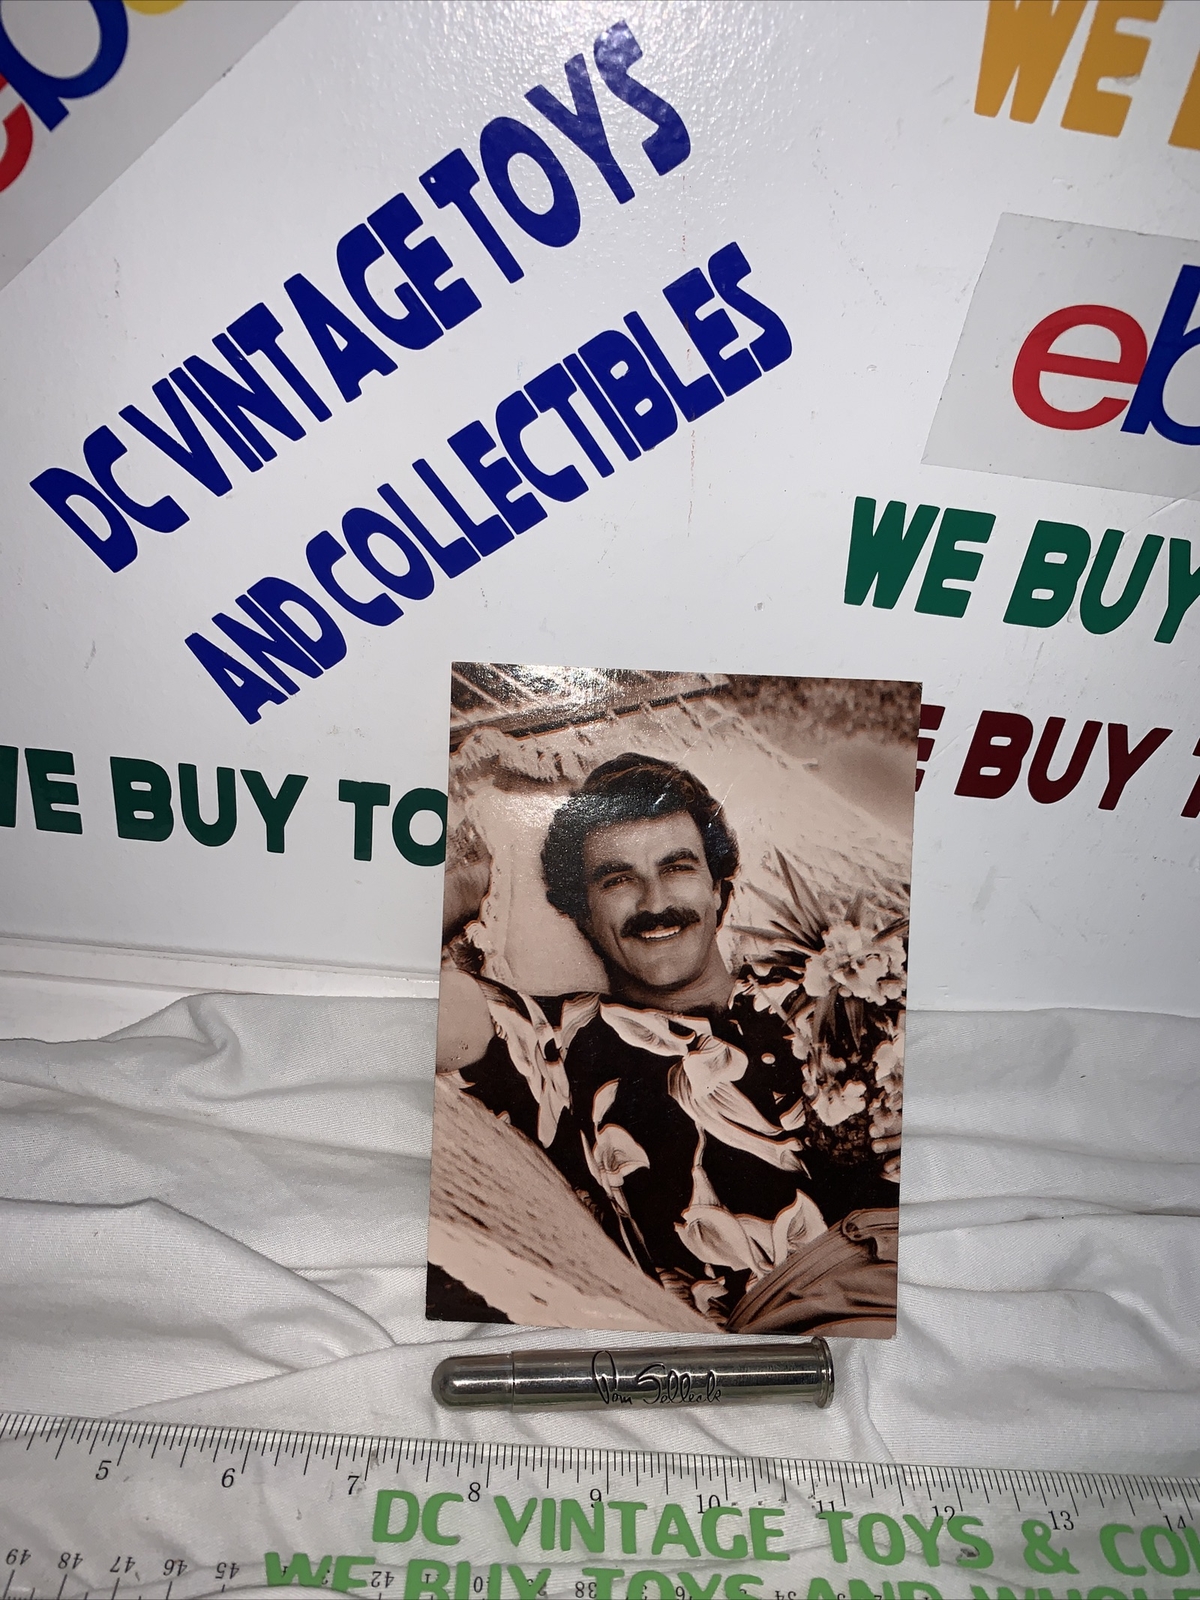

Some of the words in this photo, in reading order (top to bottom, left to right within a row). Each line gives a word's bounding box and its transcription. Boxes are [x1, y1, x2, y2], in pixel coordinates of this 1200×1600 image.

[973, 0, 1165, 138] WE
[29, 425, 190, 573] DC
[118, 192, 482, 497] VINTAGE
[418, 20, 691, 284] TOYS
[184, 576, 347, 725] AND
[305, 241, 793, 627] COLLECTIBLES
[843, 496, 997, 618] WE
[1003, 519, 1200, 644] BUY
[110, 756, 308, 854] BUY
[954, 710, 1173, 811] BUY
[95, 1460, 112, 1480] 5
[221, 1468, 235, 1488] 6
[346, 1475, 360, 1495] 7
[468, 1482, 481, 1502] 8
[589, 1488, 602, 1509] 9
[696, 1494, 721, 1514] 10
[1048, 1510, 1075, 1531] 13
[371, 1489, 464, 1546] DC
[493, 1495, 789, 1561] VINTAGE
[816, 1510, 995, 1569] TOYS
[1021, 1519, 1080, 1575] &
[6, 1548, 32, 1566] 49
[58, 1552, 84, 1570] 48
[109, 1555, 136, 1574] 47
[163, 1559, 188, 1577] 46
[215, 1562, 240, 1580] 45
[371, 1571, 395, 1588] 42
[403, 1559, 552, 1600] BUY
